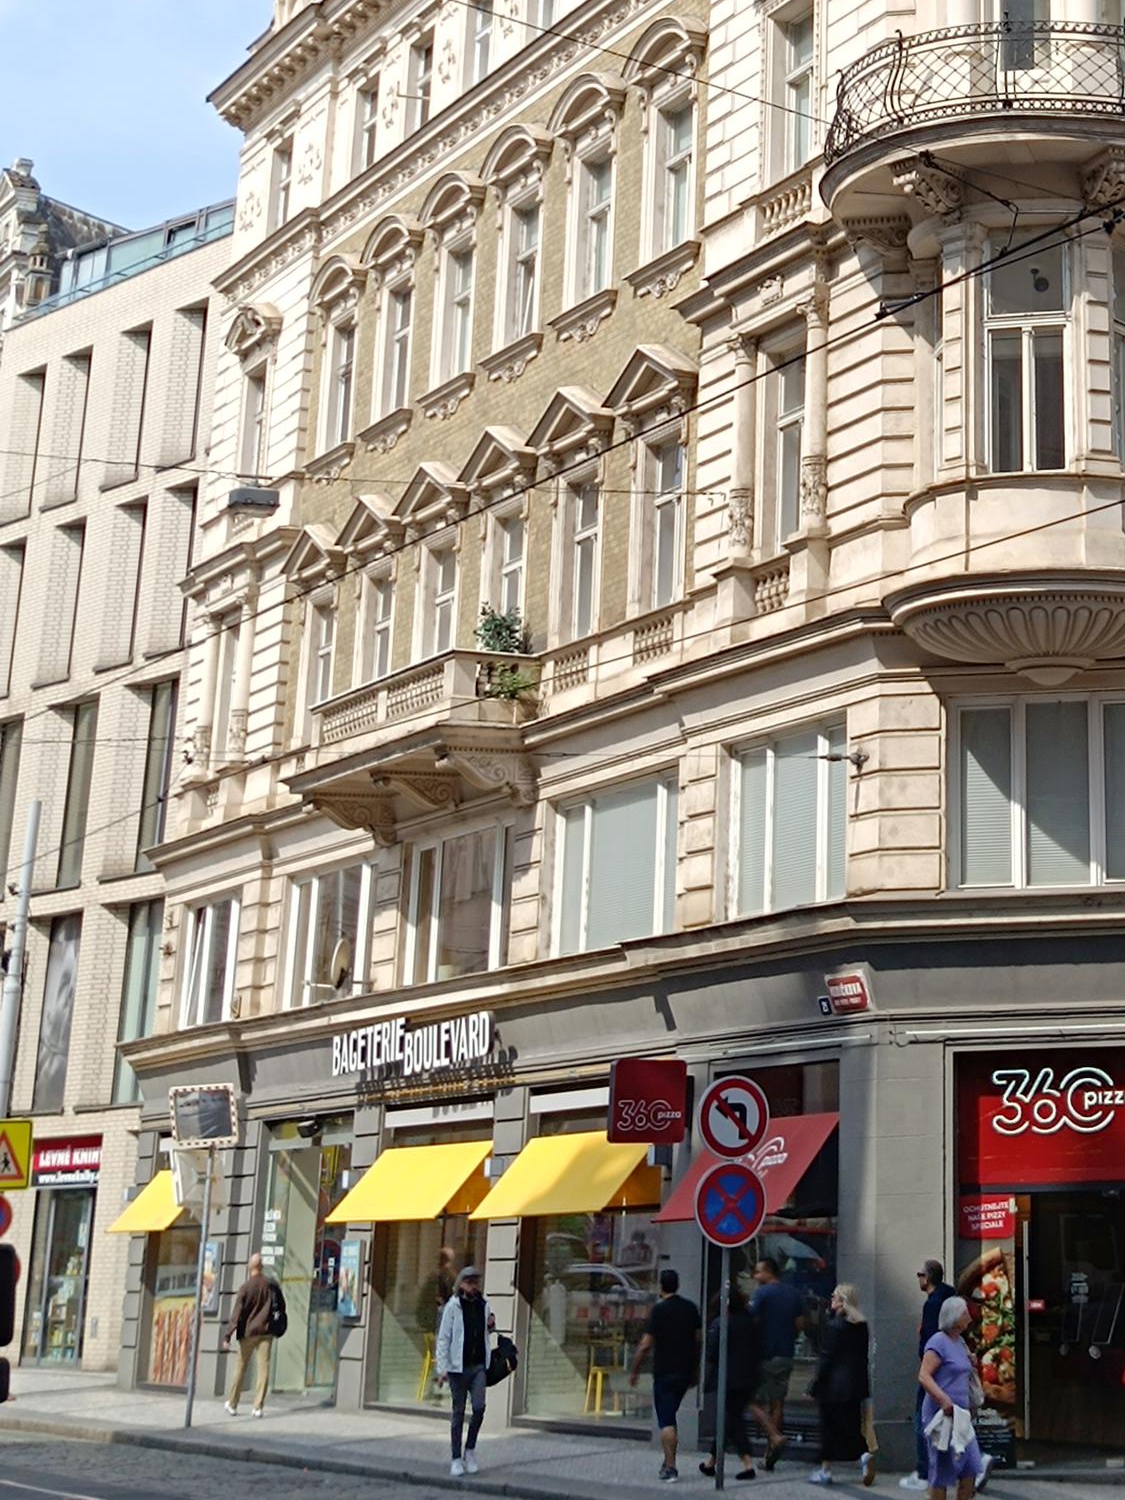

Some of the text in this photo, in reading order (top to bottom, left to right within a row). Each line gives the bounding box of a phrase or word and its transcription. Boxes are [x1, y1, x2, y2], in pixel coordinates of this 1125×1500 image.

[332, 1010, 495, 1077] BAGETERIE BOULEVARD
[617, 1099, 682, 1132] 360 pizza
[992, 1066, 1115, 1135] 360
[38, 1145, 100, 1168] LEVNÉ KNIH
